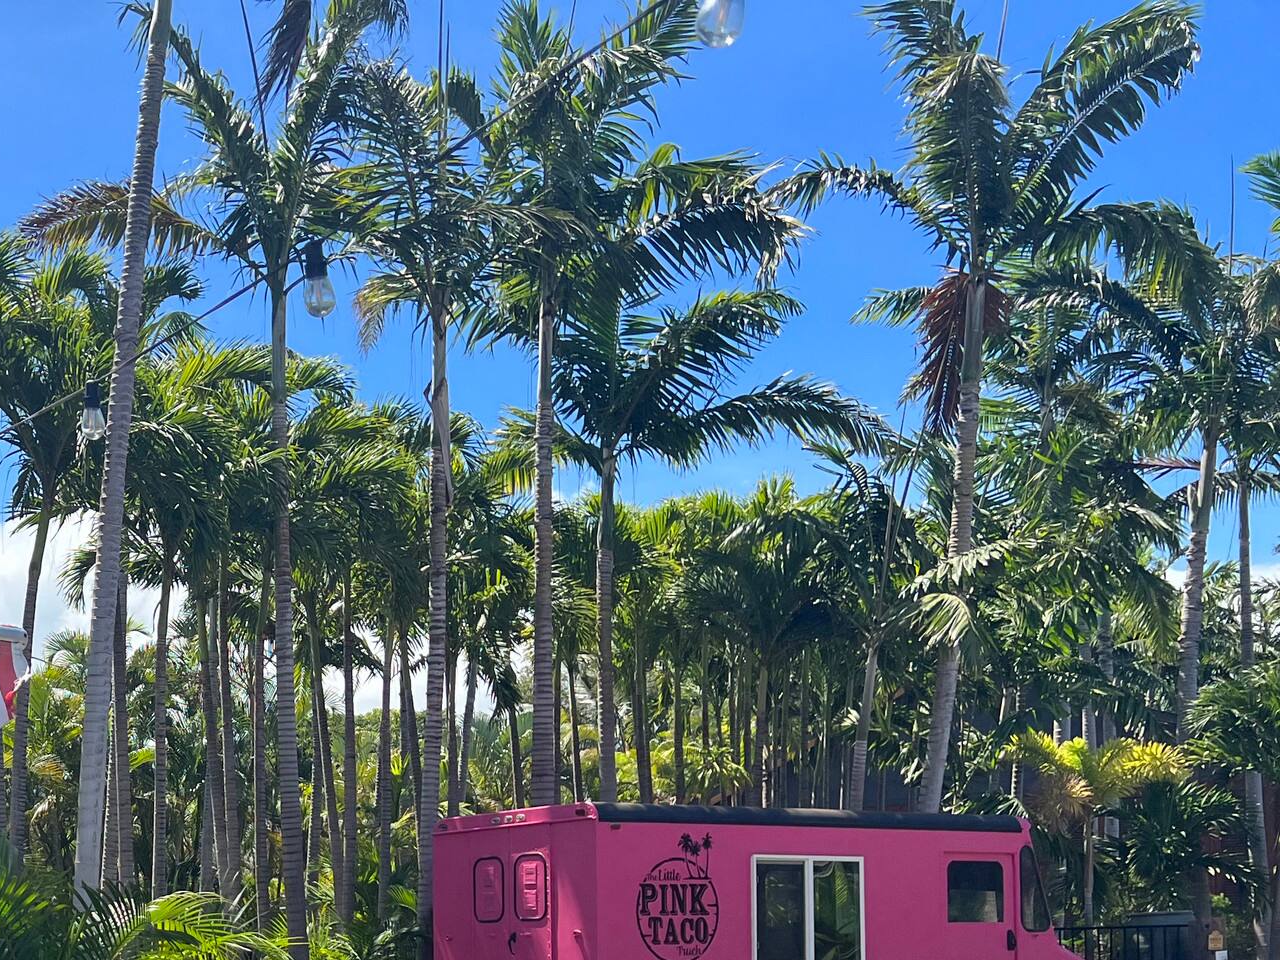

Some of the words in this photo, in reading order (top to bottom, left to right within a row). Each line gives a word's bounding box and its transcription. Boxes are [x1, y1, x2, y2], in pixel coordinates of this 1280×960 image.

[658, 868, 680, 881] Little
[639, 883, 710, 916] PINK
[648, 917, 709, 945] TACO
